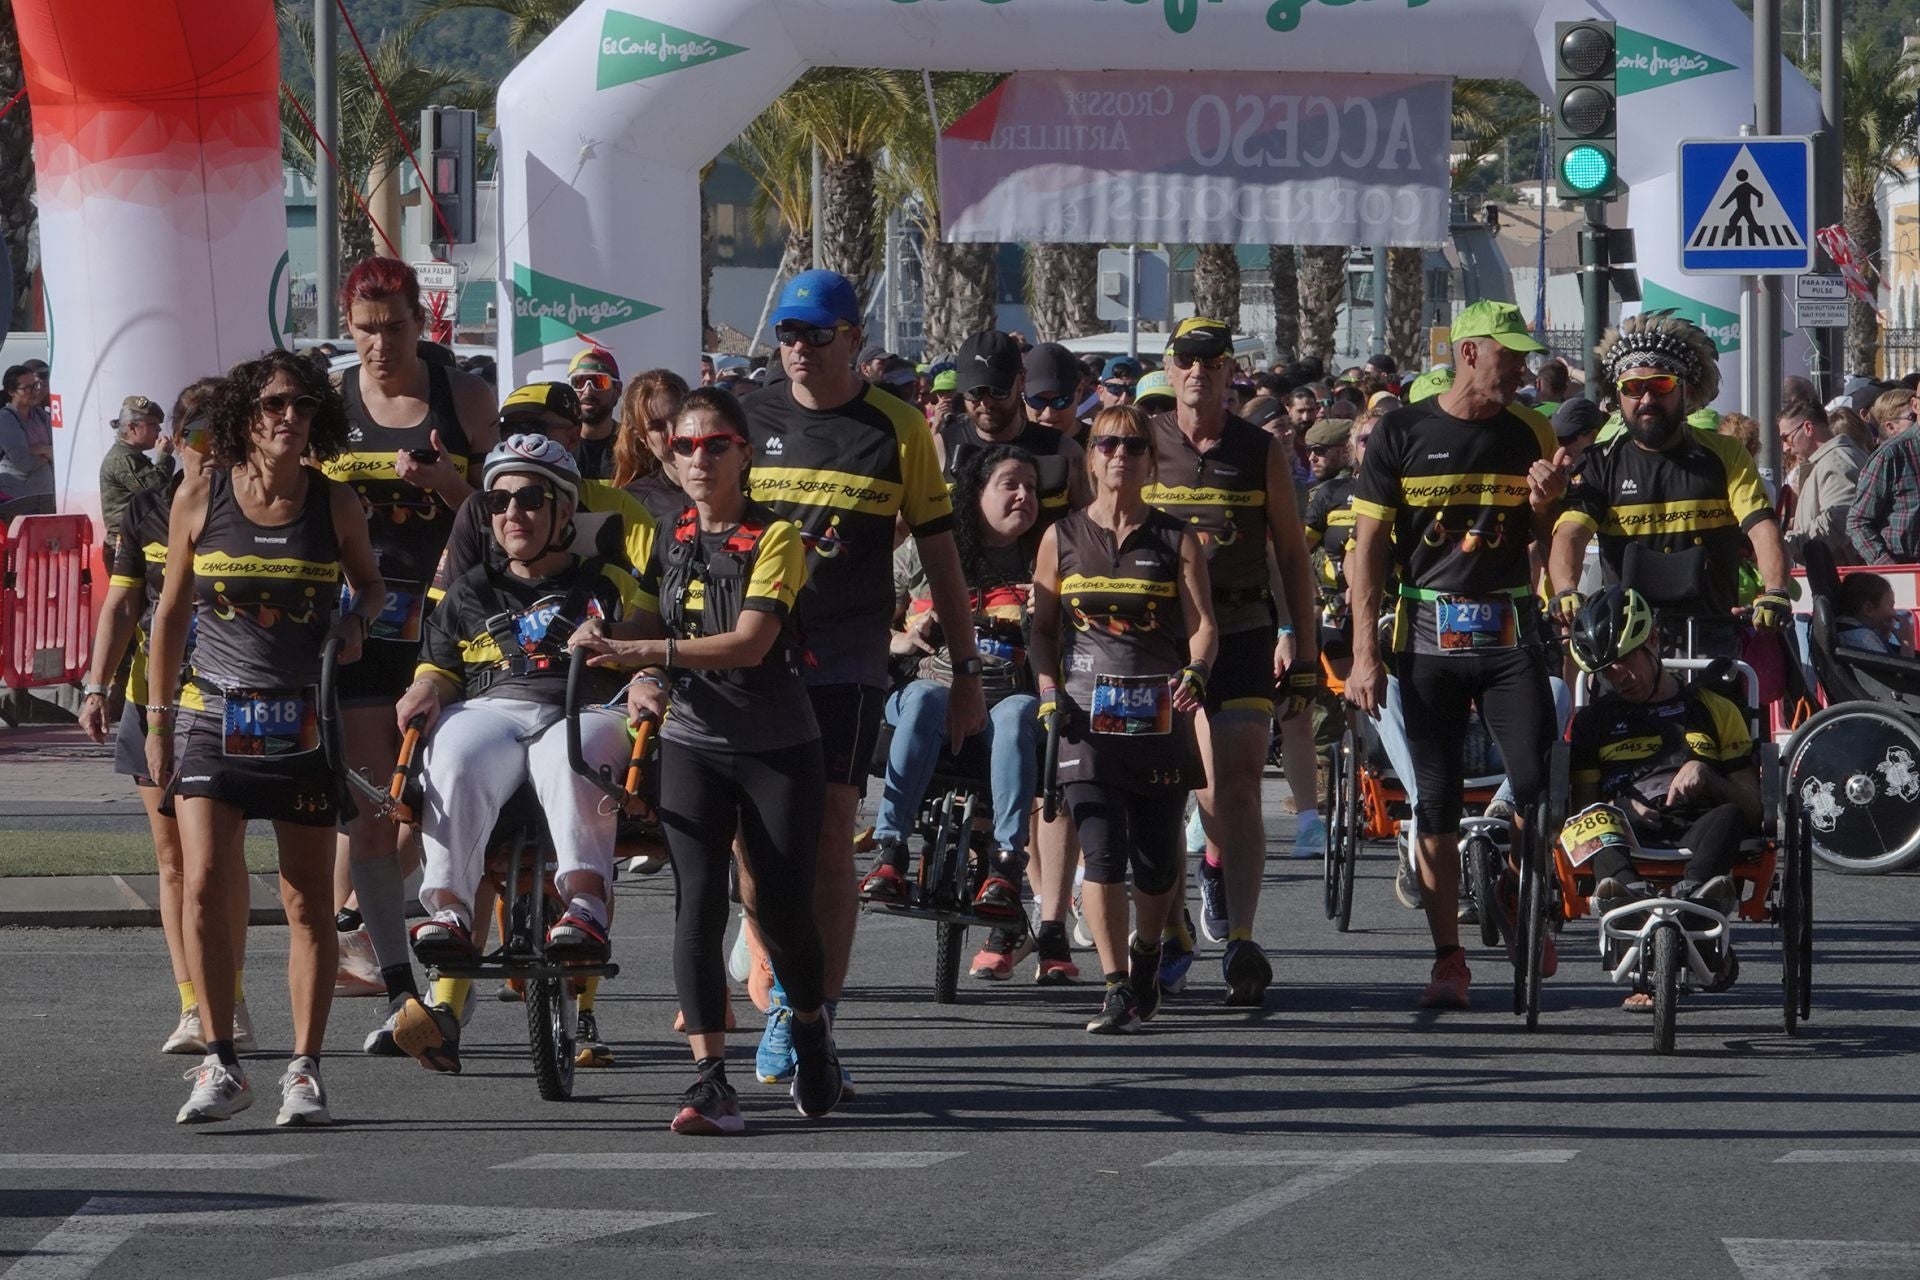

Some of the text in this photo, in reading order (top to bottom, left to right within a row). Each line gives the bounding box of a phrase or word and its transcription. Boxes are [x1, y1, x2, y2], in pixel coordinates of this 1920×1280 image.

[602, 33, 718, 62] El Corte Inglés
[1649, 46, 1709, 76] Inglés
[424, 276, 443, 285] PULSE
[528, 298, 566, 318] Corte
[567, 293, 633, 325] Inglés
[1427, 451, 1450, 460] mobel
[790, 480, 839, 492] SOBRE
[841, 485, 892, 504] RUEDAS
[1186, 493, 1216, 501] SOBRE
[1404, 484, 1462, 498] ZANCADAS
[1460, 483, 1502, 496] SOBRE
[1655, 510, 1695, 524] SOBRE
[201, 562, 336, 577] ZANCADAS SOBRE RUEDAS
[1103, 581, 1138, 591] SOBRE
[1456, 603, 1493, 622] 279
[1107, 687, 1153, 707] 1454
[240, 700, 297, 723] 1618
[1572, 811, 1618, 838] 2862
